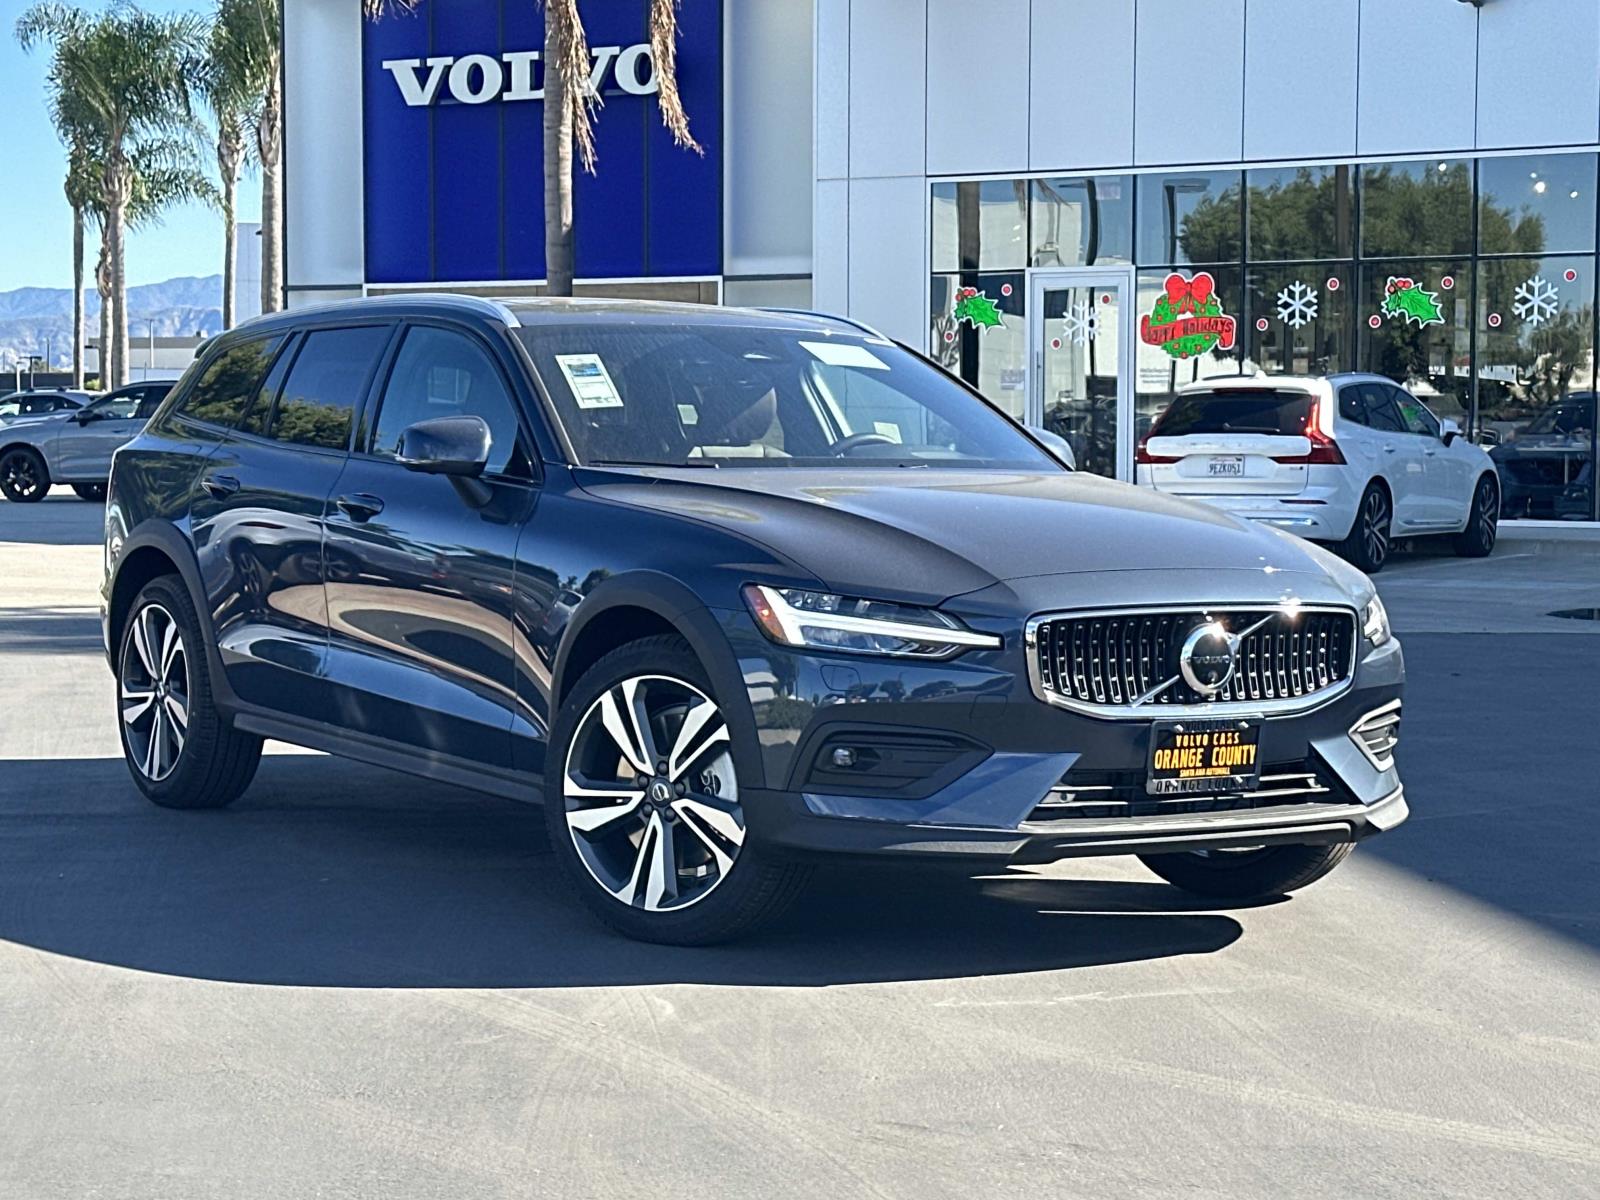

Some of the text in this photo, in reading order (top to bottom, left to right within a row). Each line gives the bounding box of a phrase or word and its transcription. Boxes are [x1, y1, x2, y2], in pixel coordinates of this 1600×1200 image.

[1176, 734, 1208, 747] VOLVO
[1154, 744, 1256, 769] ORANGE COUNTY
